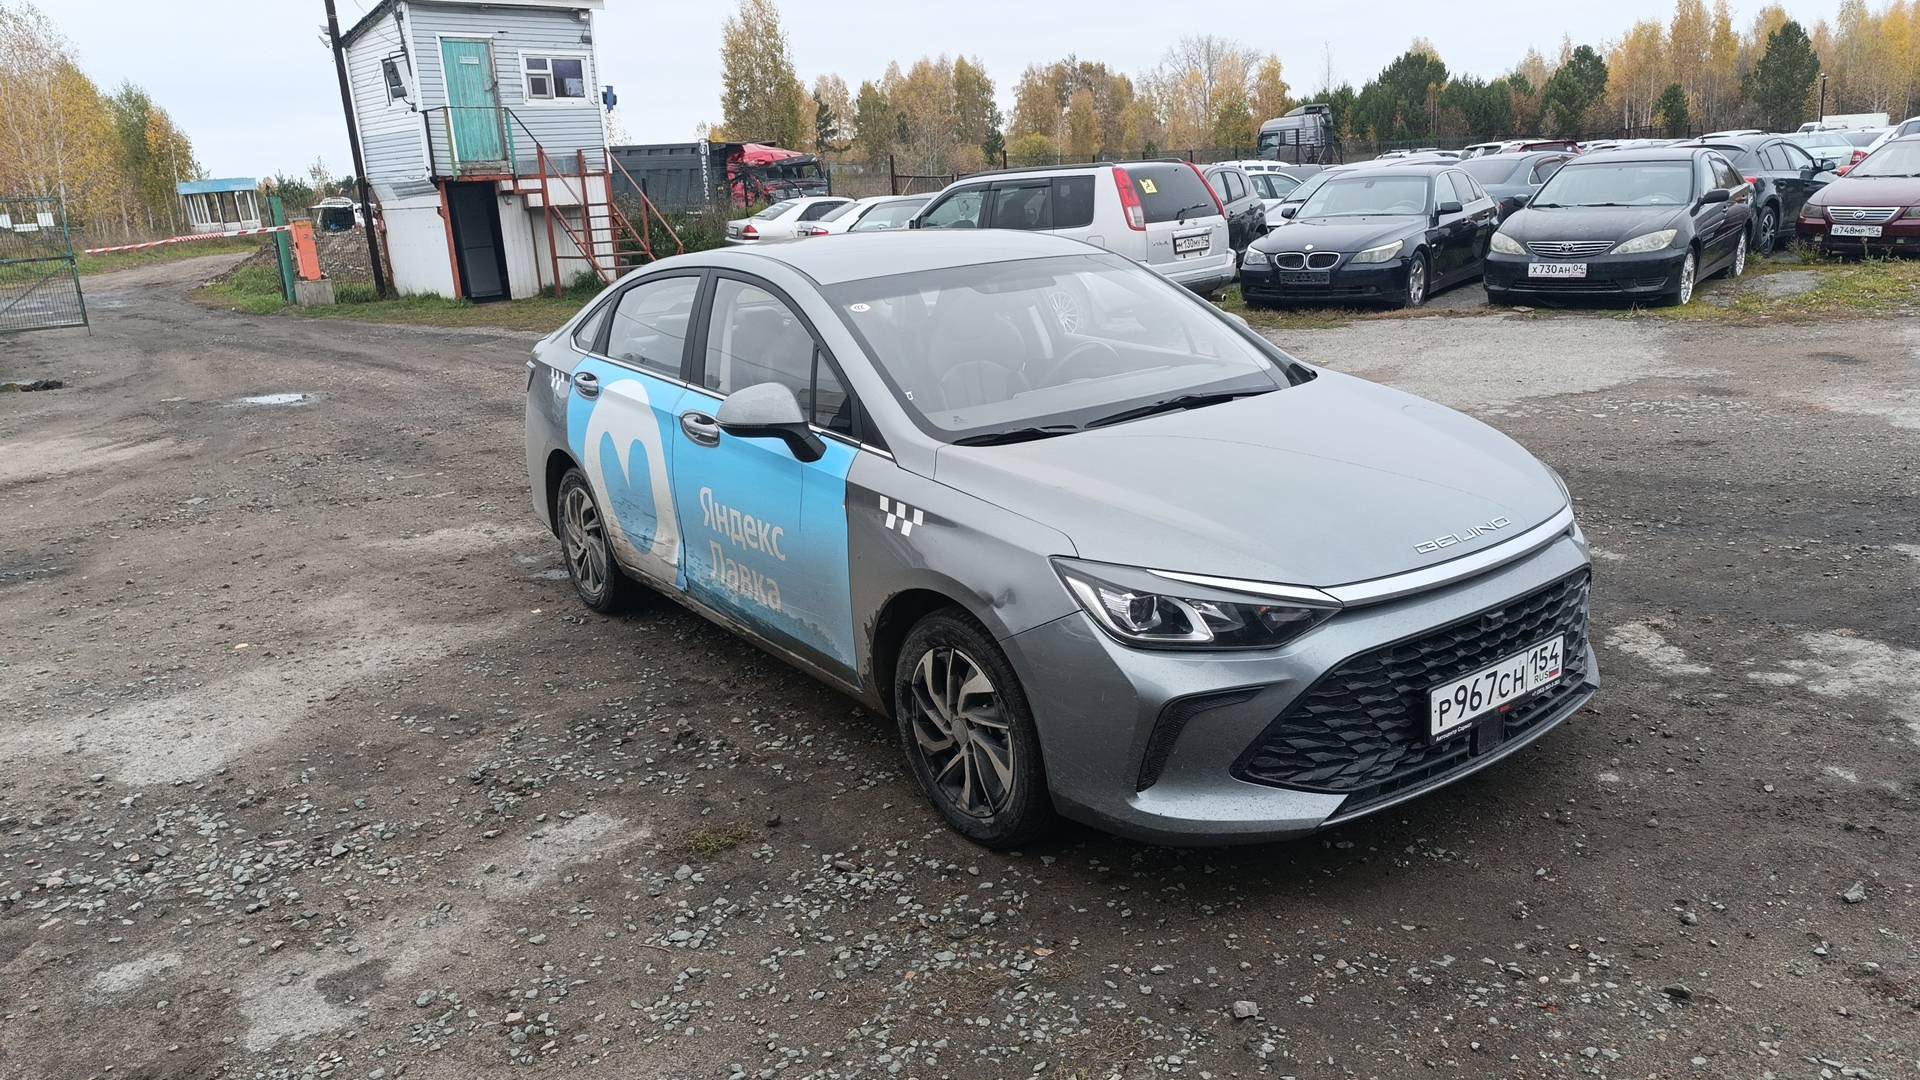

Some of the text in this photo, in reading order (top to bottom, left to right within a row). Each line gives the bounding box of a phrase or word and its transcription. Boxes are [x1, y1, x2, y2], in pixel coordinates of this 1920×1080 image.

[700, 487, 786, 560] Яндекс
[709, 539, 784, 612] Лавка
[1438, 641, 1560, 727] Р967СН 154
[1534, 670, 1549, 684] RUS
